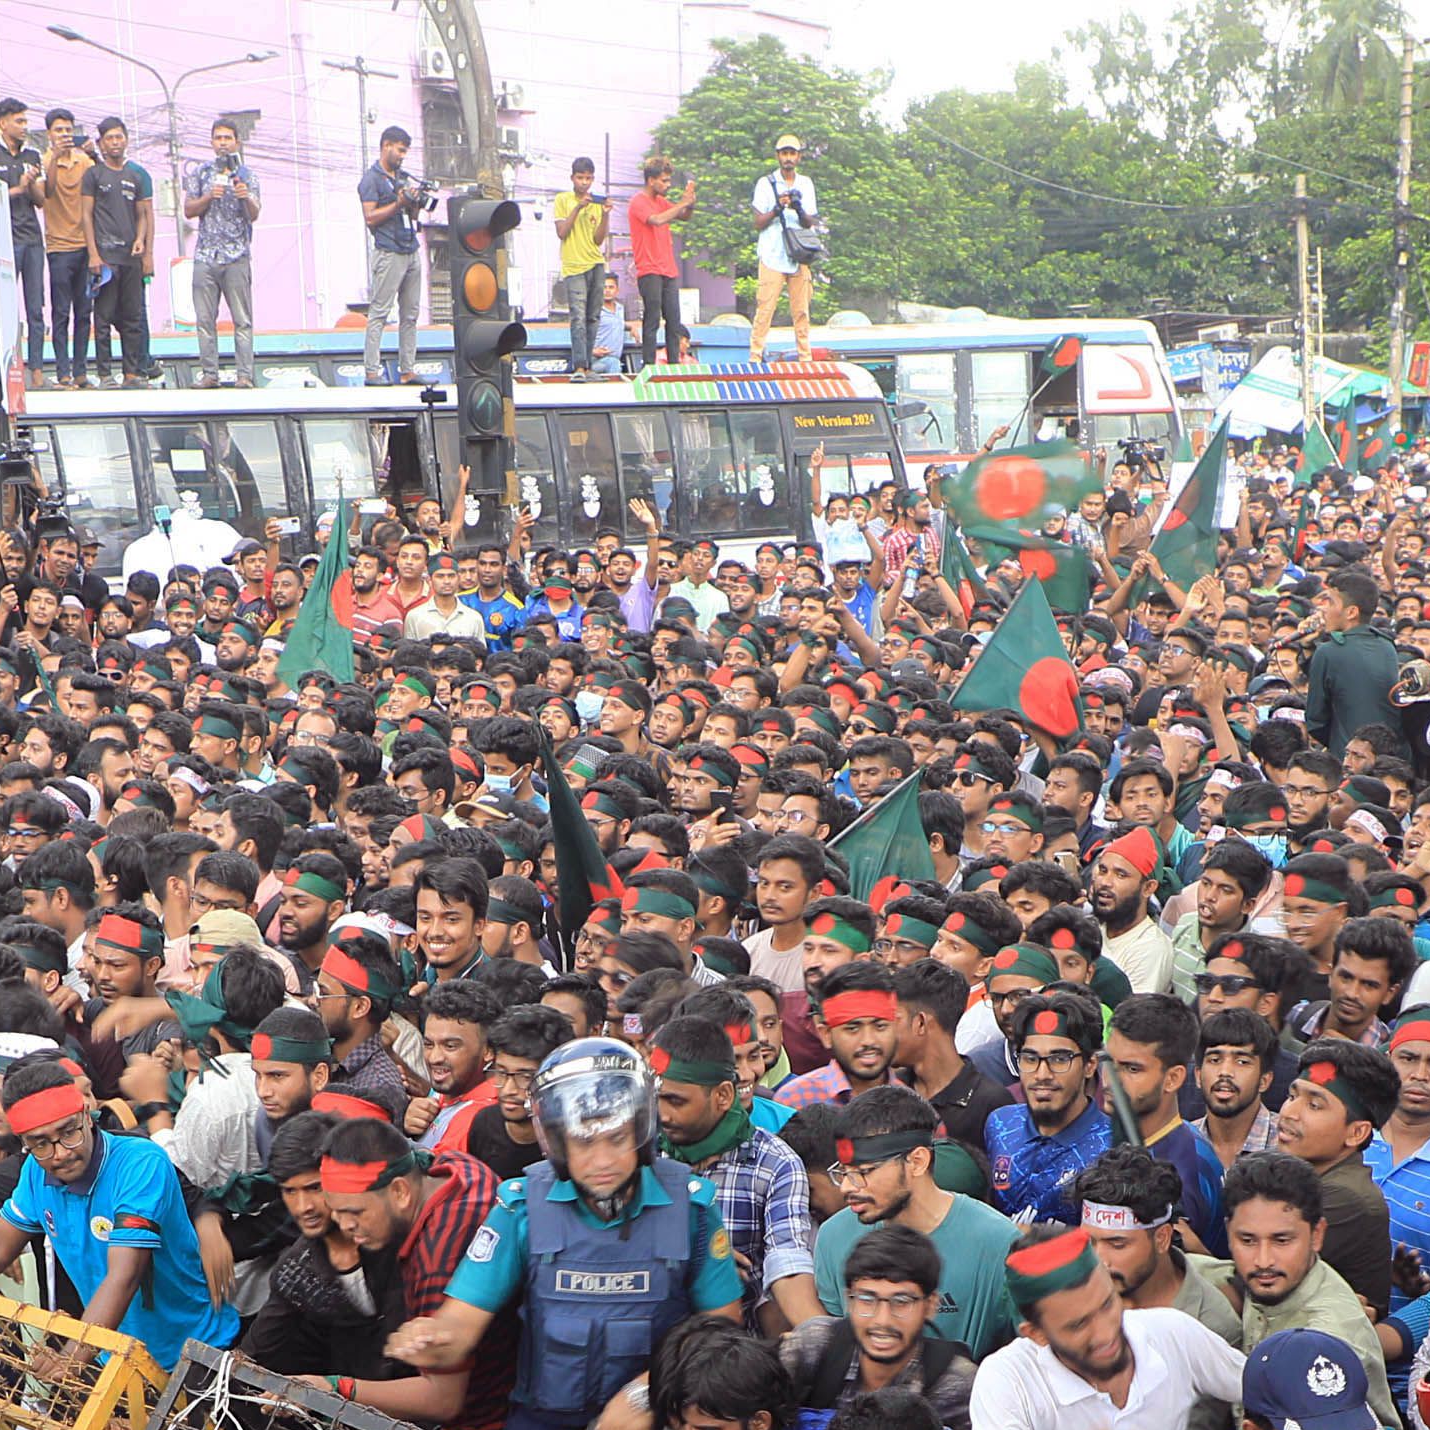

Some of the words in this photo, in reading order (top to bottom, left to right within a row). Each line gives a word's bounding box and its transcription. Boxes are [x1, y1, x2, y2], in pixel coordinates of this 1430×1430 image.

[794, 415, 815, 428] New
[816, 414, 852, 428] Version
[853, 413, 875, 426] 2024
[1096, 1208, 1126, 1227] দেশ
[571, 1273, 635, 1291] POLICE
